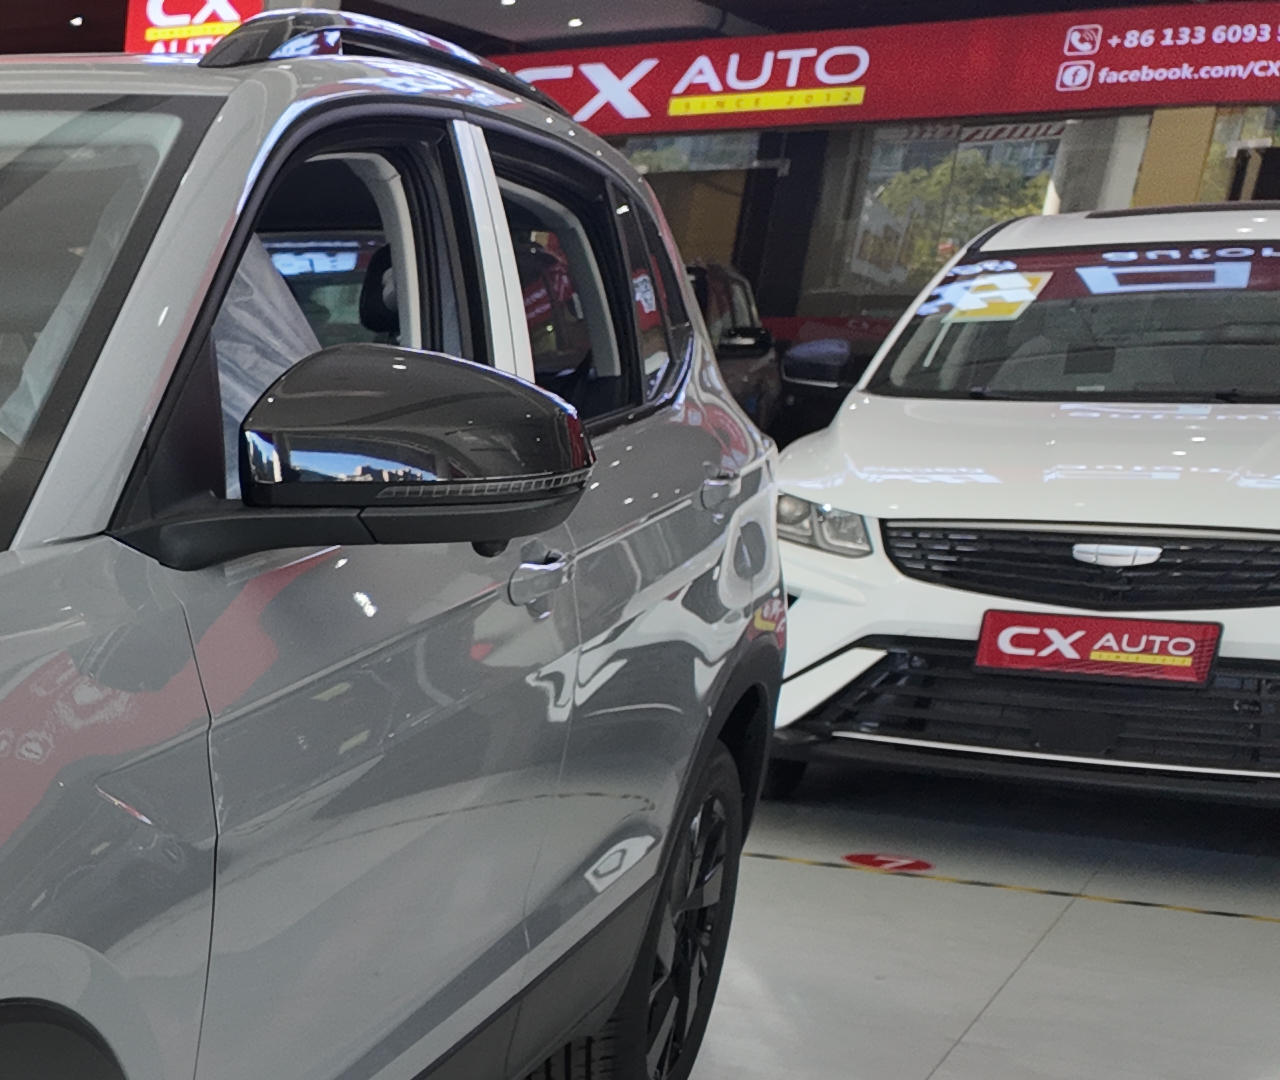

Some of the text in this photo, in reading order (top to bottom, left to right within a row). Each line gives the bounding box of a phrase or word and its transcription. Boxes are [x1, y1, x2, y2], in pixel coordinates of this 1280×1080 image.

[1107, 29, 1155, 48] +86
[1159, 26, 1206, 46] 133
[1211, 24, 1271, 43] 6093
[671, 45, 870, 94] AUTO
[683, 92, 853, 112] SINCE 2012
[997, 626, 1196, 660] CX AUTO
